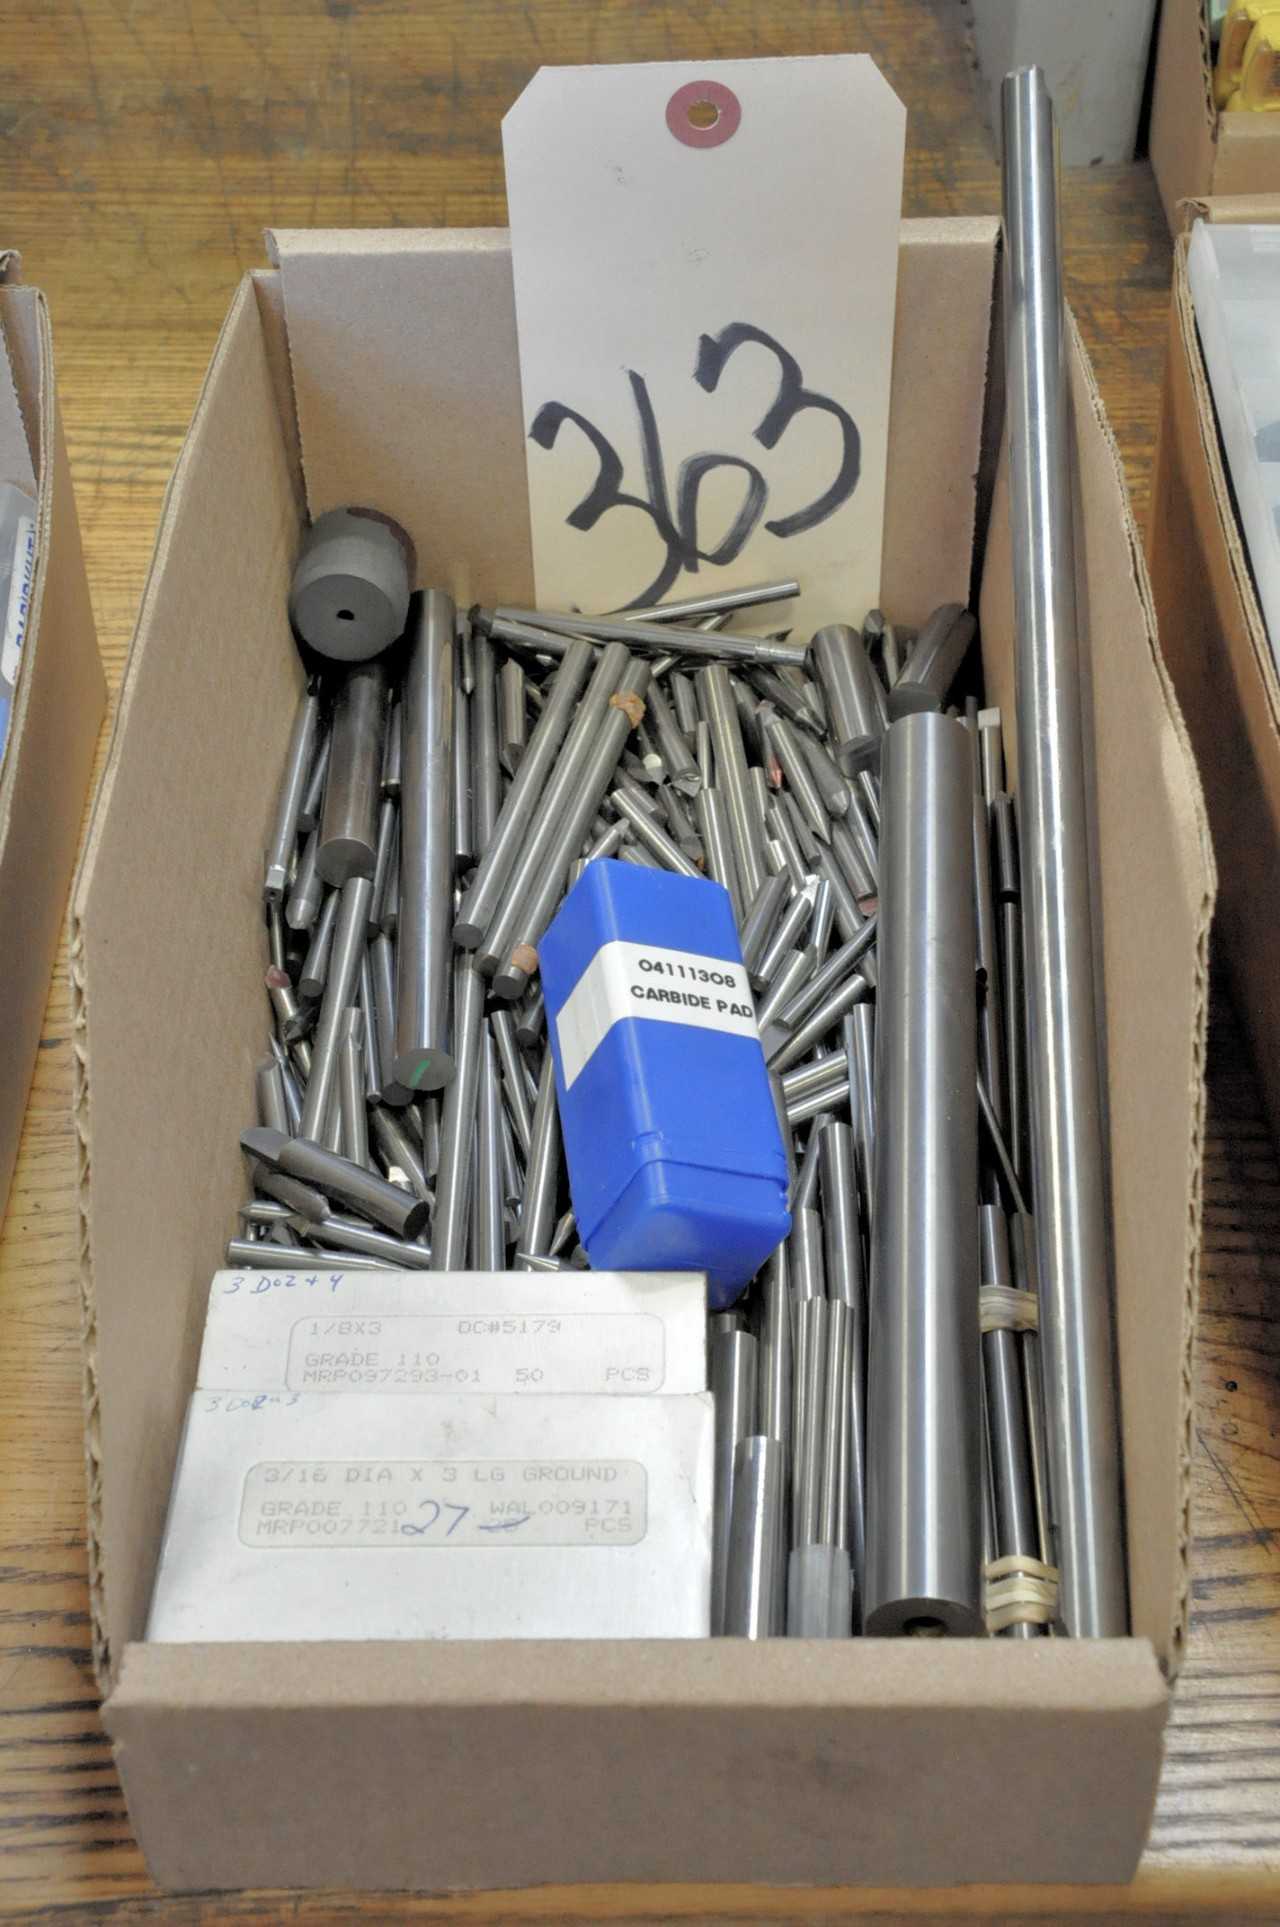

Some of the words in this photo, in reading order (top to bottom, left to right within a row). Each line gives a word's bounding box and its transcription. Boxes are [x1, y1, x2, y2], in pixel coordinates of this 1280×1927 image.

[528, 322, 861, 615] 363
[638, 958, 737, 989] 04111308
[630, 984, 712, 1010] CARBIDE
[716, 999, 754, 1019] PAD
[310, 1321, 382, 1336] 1/8X3
[304, 1352, 380, 1367] GRADE
[397, 1352, 441, 1367] 110
[515, 1368, 545, 1383] 50
[605, 1367, 652, 1382] PCS
[263, 1467, 328, 1483] 3/16
[344, 1467, 394, 1483] DIA
[410, 1467, 424, 1482] X
[441, 1467, 457, 1482] 3
[473, 1467, 505, 1482] LG
[522, 1467, 618, 1482] GROUND
[261, 1501, 342, 1517] GRADE
[362, 1500, 408, 1516] 110
[401, 1499, 470, 1537] 27
[584, 1518, 633, 1533] PCS
